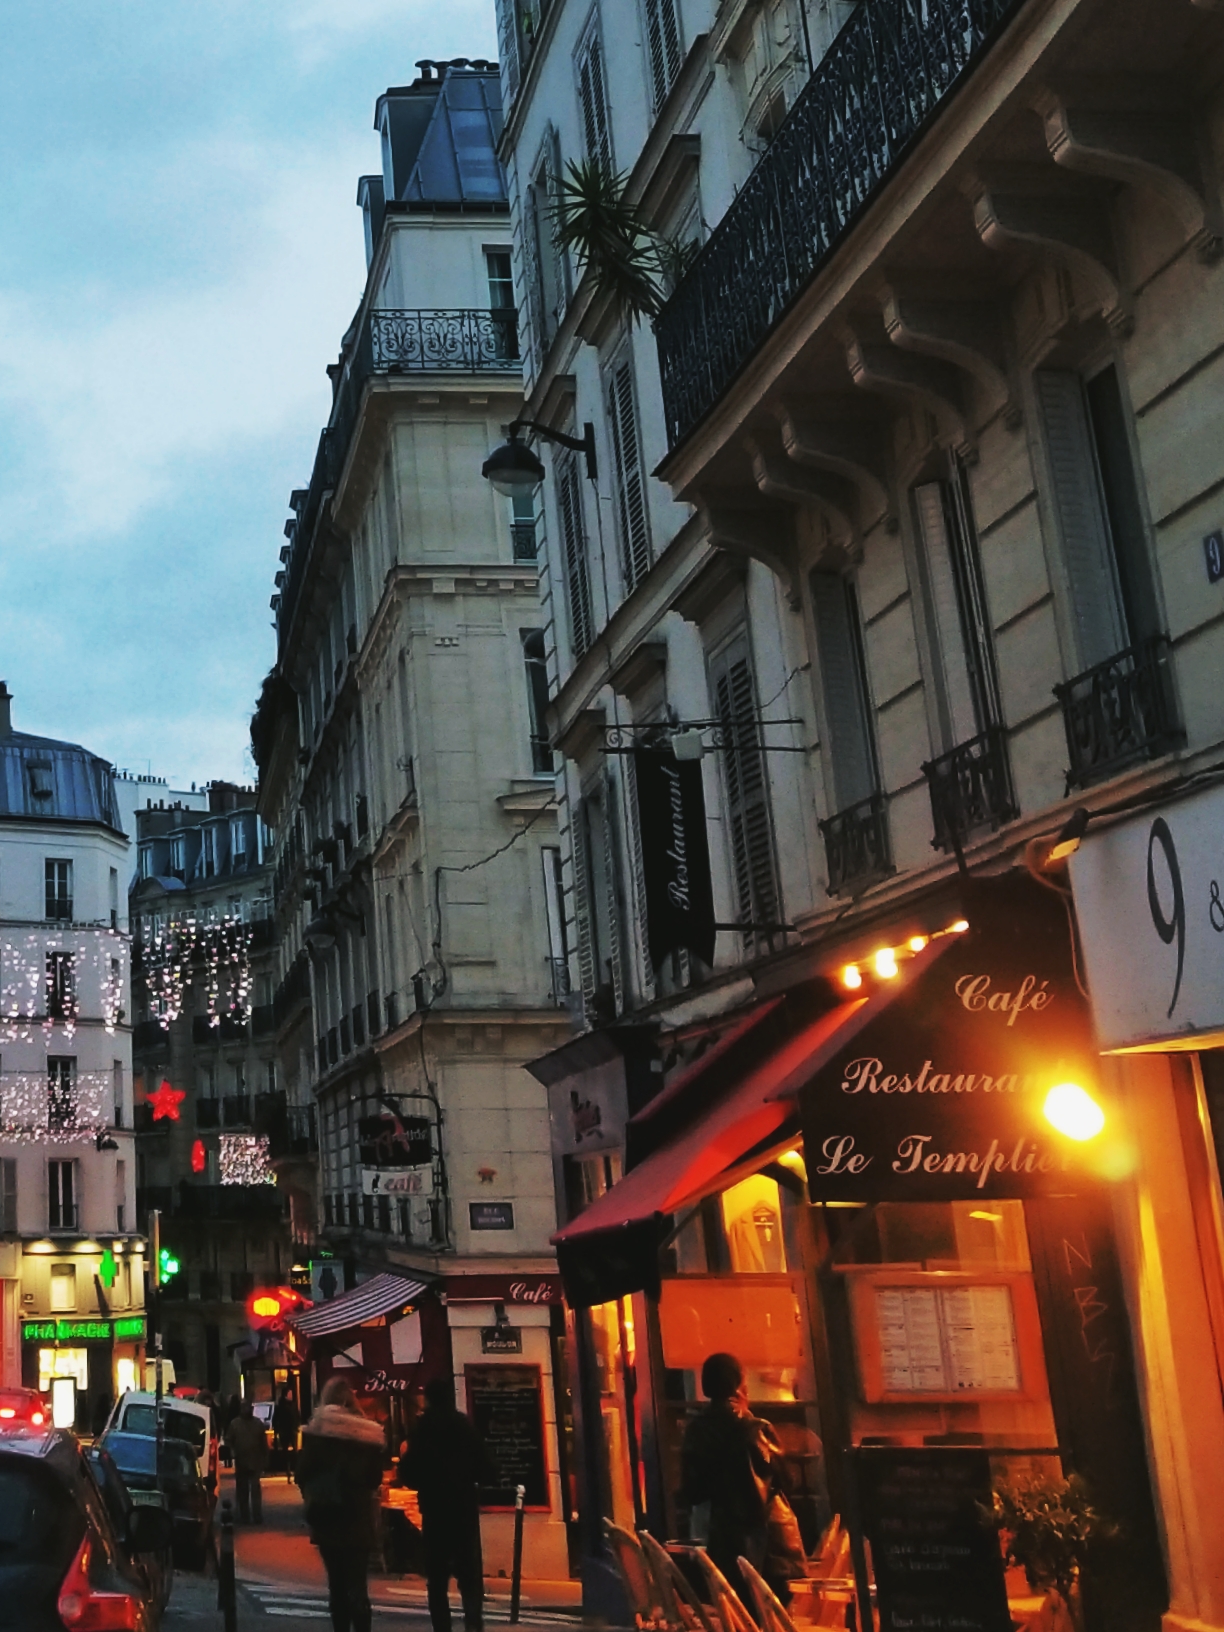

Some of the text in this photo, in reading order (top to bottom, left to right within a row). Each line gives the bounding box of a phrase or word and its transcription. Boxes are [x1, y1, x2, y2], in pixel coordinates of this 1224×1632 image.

[660, 765, 690, 911] Restaurant
[1146, 816, 1186, 1019] 9
[954, 974, 1054, 1027] Café
[815, 1134, 874, 1175] Le
[509, 1281, 554, 1304] Café
[364, 1368, 411, 1393] Bar
